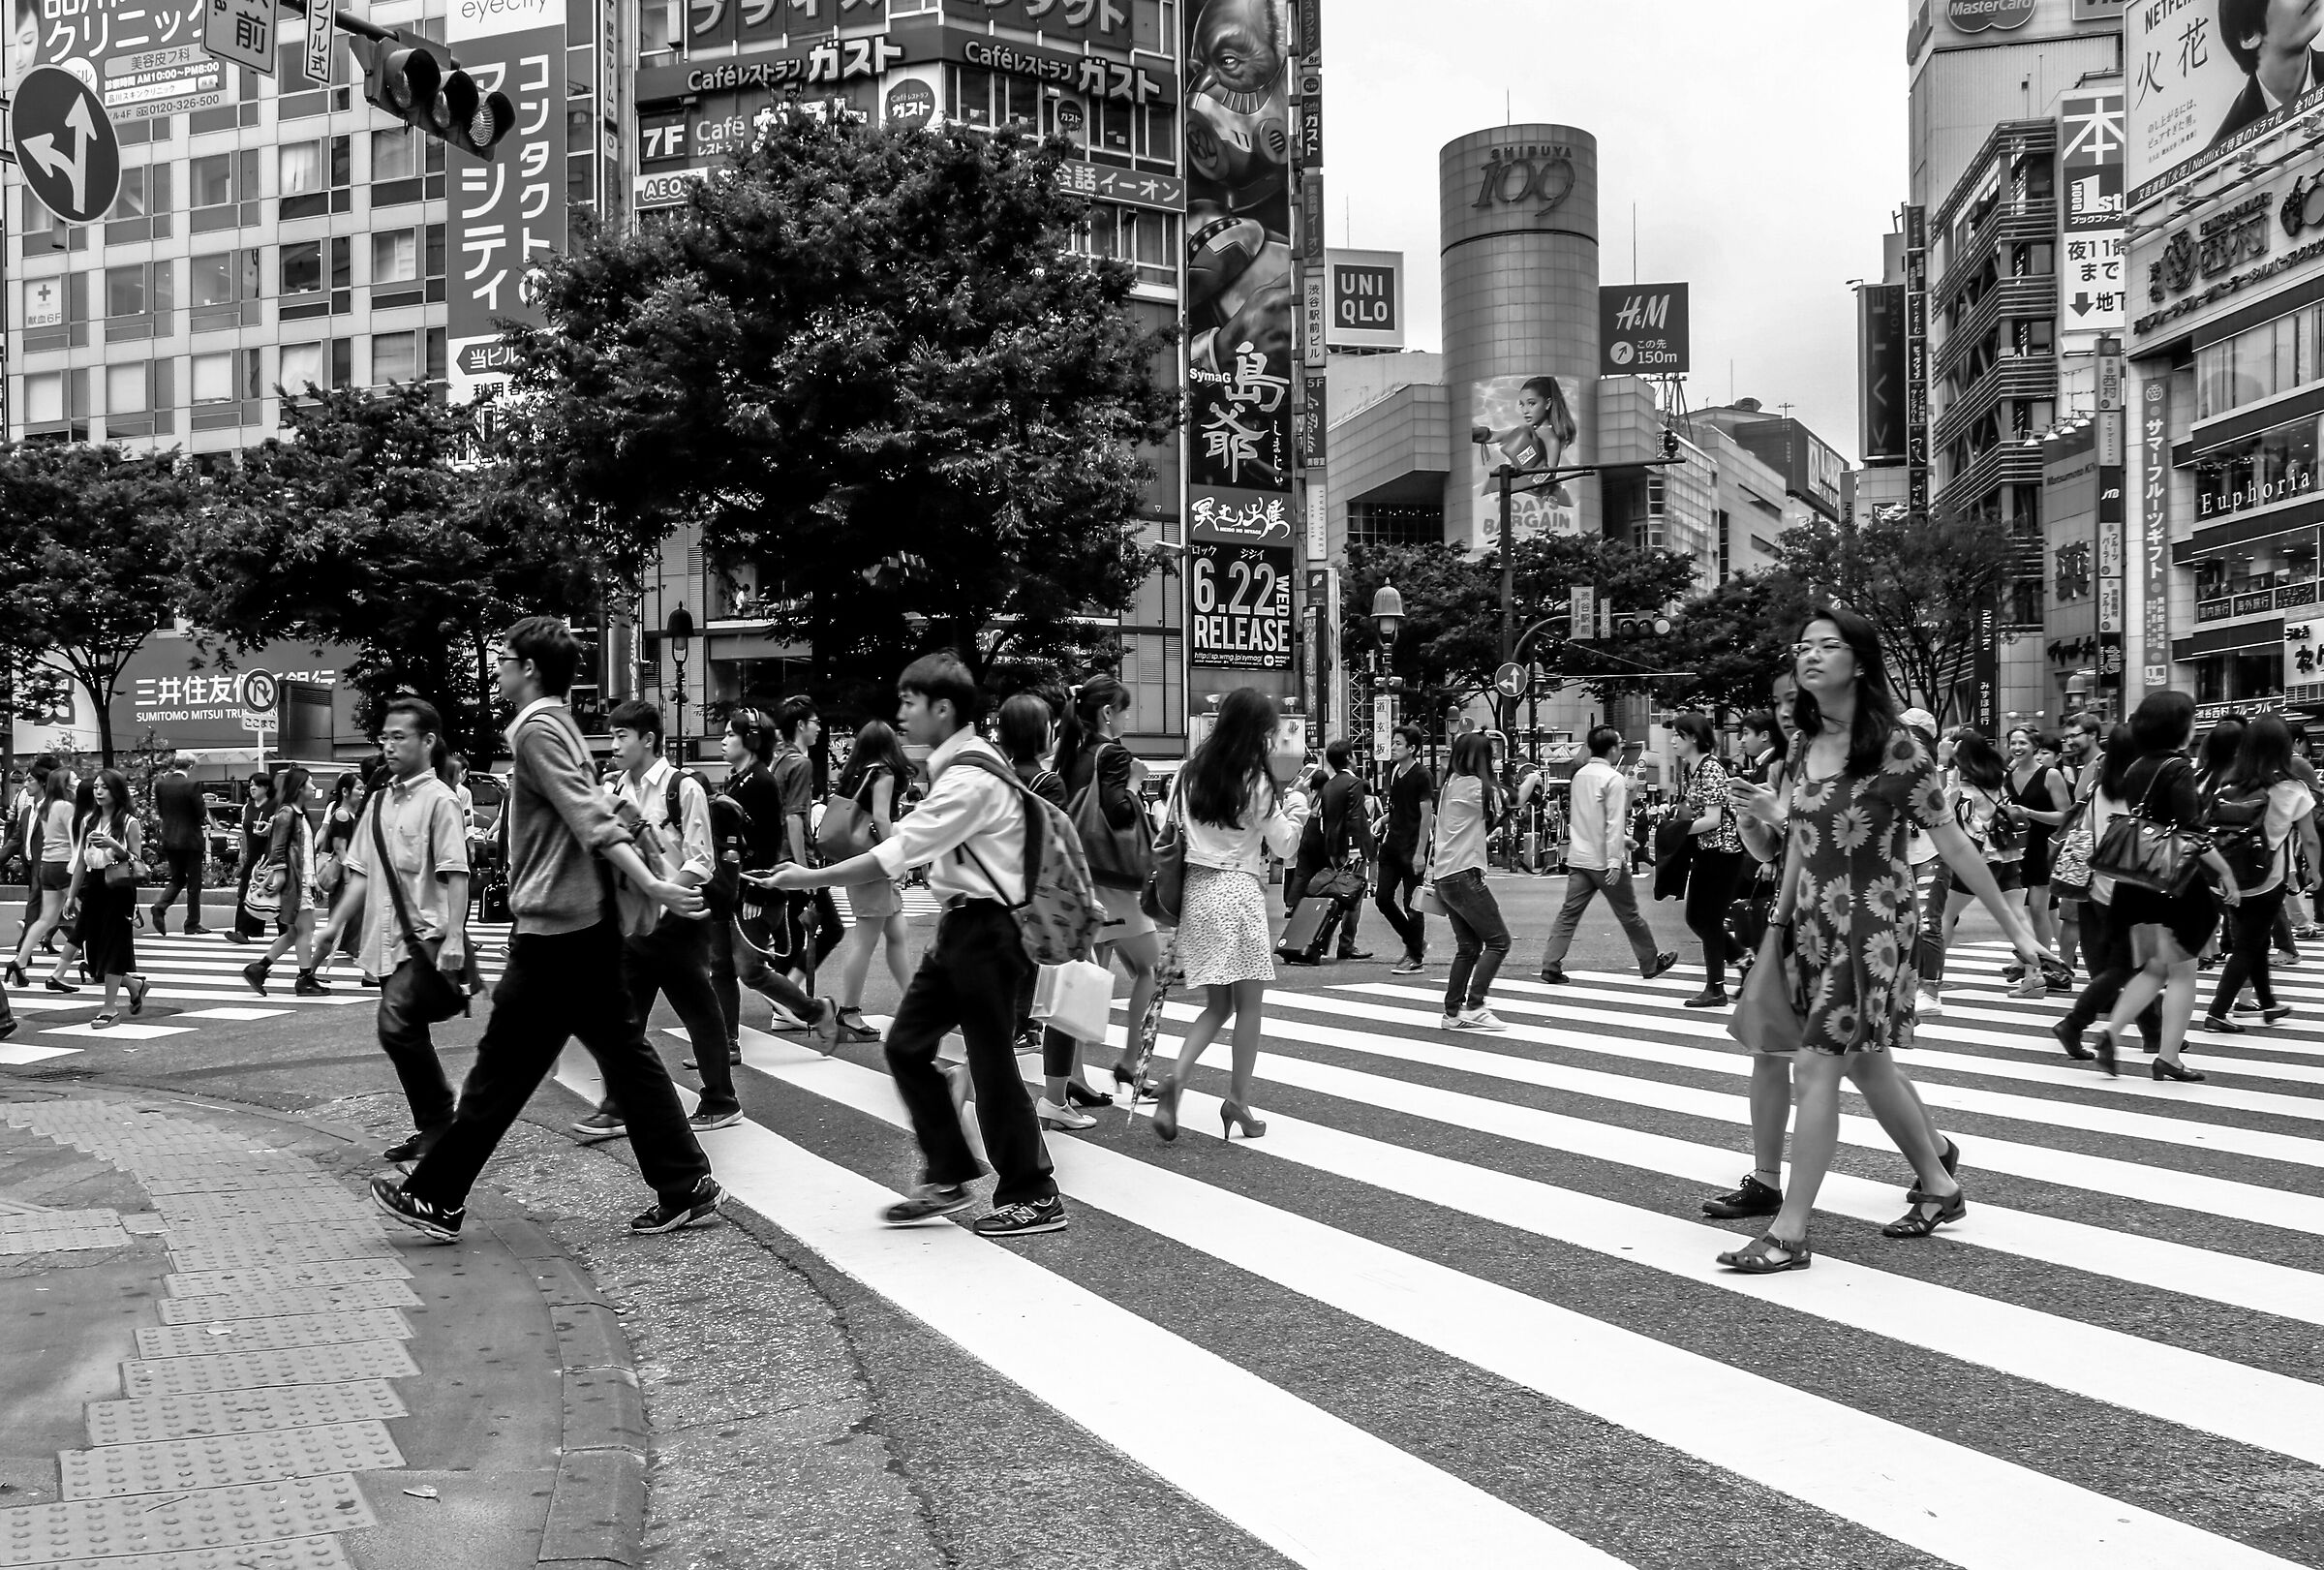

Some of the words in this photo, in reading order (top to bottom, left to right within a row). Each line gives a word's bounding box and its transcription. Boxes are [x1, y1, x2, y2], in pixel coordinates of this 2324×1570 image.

[236, 0, 267, 54] 前
[132, 46, 190, 71] 美容皮フ科
[808, 36, 902, 83] ガスト
[1079, 58, 1160, 104] ガスト
[892, 103, 930, 118] ガスト
[643, 124, 685, 158] 7F
[695, 115, 746, 142] Café
[1306, 114, 1318, 156] ガスト
[2064, 98, 2124, 165] 本
[1491, 146, 1572, 160] SHIBUYA
[644, 177, 689, 201] AEO
[1472, 158, 1575, 217] 109
[2071, 174, 2123, 214] 1st
[2071, 183, 2082, 210] BOOK
[1341, 273, 1383, 295] UNI
[2081, 262, 2119, 282] まで
[1309, 284, 1320, 359] 渋谷駅前ビル
[1341, 299, 1388, 324] QLO
[1616, 294, 1669, 330] H&M
[1636, 339, 1667, 349] この先
[1637, 351, 1677, 364] 150m
[1189, 368, 1231, 384] SymaG
[1307, 379, 1324, 387] 5F
[2145, 418, 2164, 579] サマーフルーツギフト
[2201, 472, 2310, 515] Euphoria
[1483, 512, 1571, 536] BRGAIN
[1194, 558, 1275, 616] 6.22
[1276, 574, 1290, 617] WED
[2237, 596, 2269, 611] 海外旅行
[1194, 614, 1290, 652] RELEASE
[136, 710, 189, 723] SUMITOMO
[192, 709, 223, 720] MITSUI
[1980, 682, 1990, 724] みずほ銀行
[245, 718, 276, 728] ここまで
[1011, 1206, 1038, 1223] N
